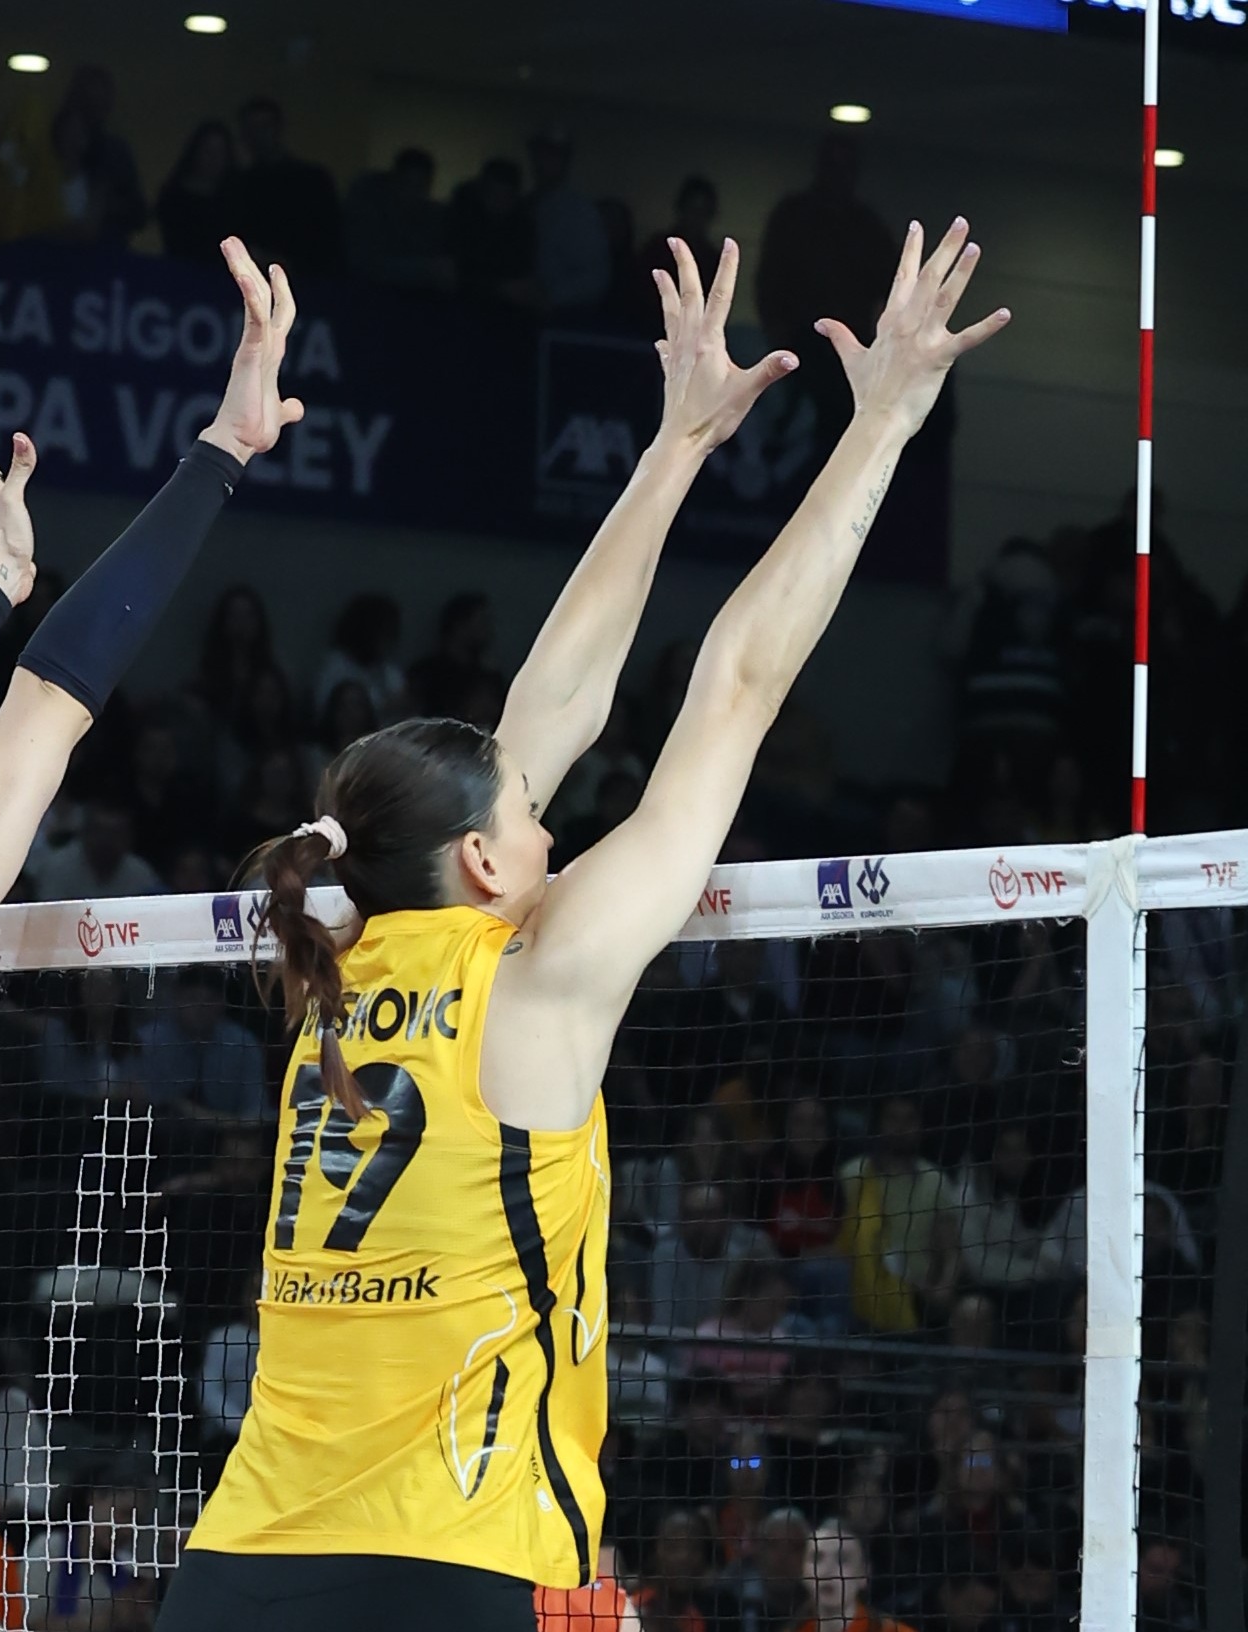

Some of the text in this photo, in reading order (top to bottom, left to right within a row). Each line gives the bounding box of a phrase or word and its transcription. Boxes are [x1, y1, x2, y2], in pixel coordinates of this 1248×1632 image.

[71, 277, 343, 383] SİGOA
[1021, 871, 1068, 897] TVF
[1200, 861, 1239, 888] TVF
[104, 922, 140, 947] TVF
[273, 1062, 427, 1252] 19
